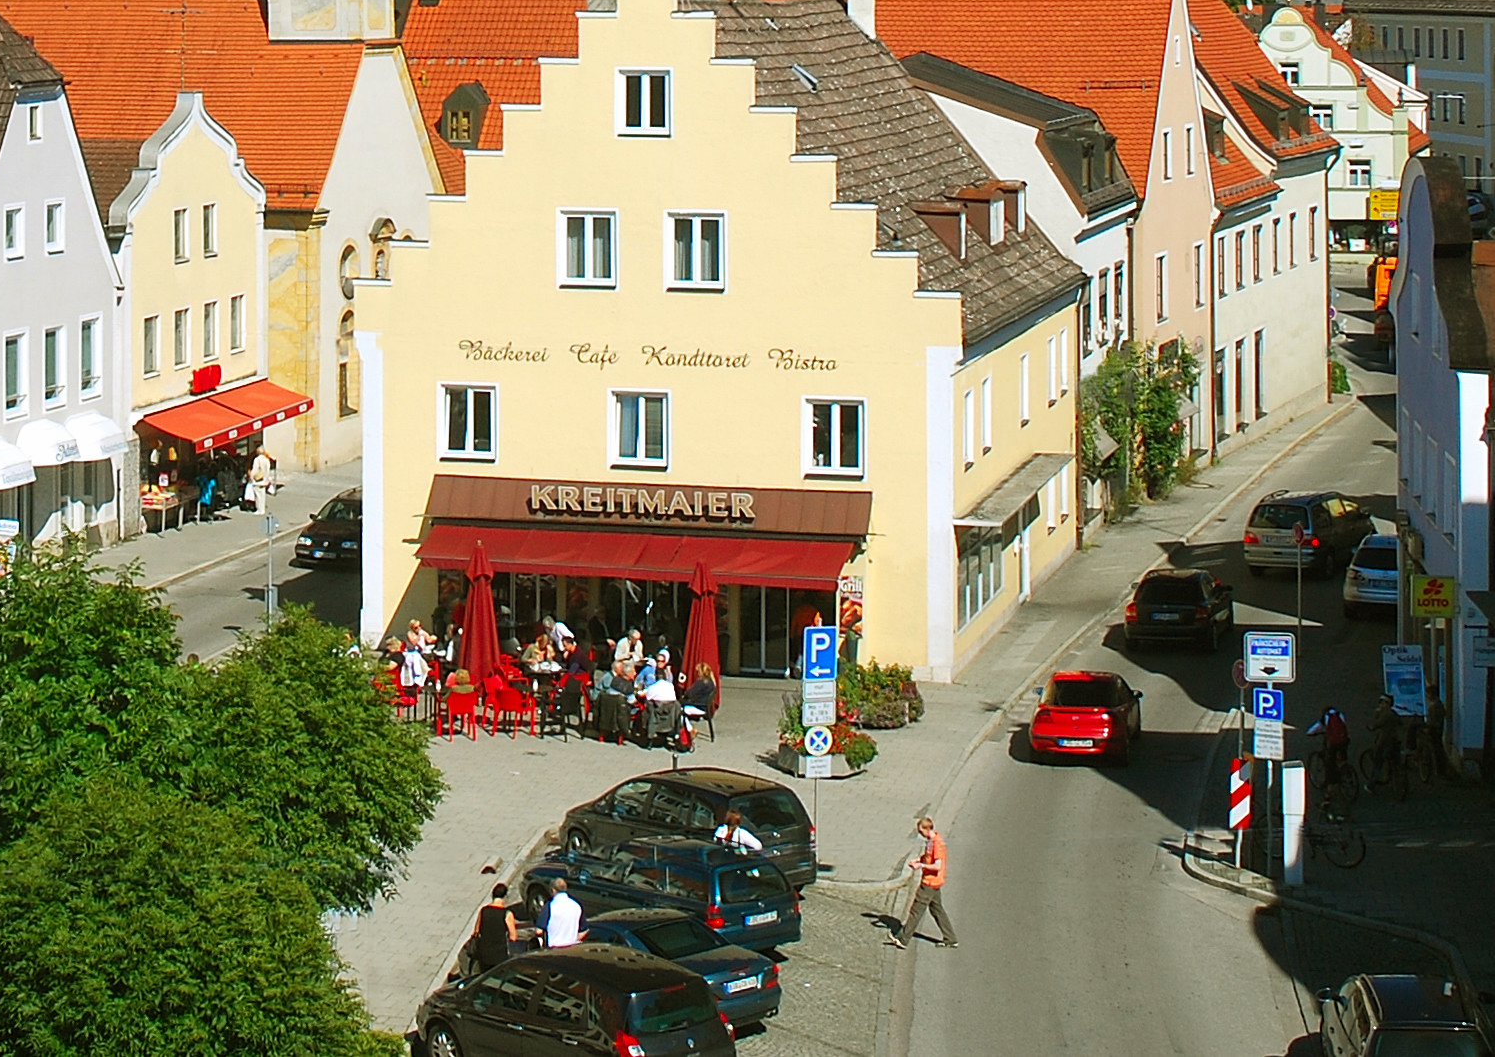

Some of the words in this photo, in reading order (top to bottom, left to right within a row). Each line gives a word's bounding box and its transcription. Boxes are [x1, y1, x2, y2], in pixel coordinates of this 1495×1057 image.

[459, 340, 549, 363] Bäckerei
[768, 348, 839, 371] Bistro
[530, 484, 756, 518] KREITMAIER
[1417, 598, 1449, 607] LOTTO
[811, 632, 831, 664] P
[1383, 645, 1408, 655] Optik
[1258, 692, 1274, 716] P
